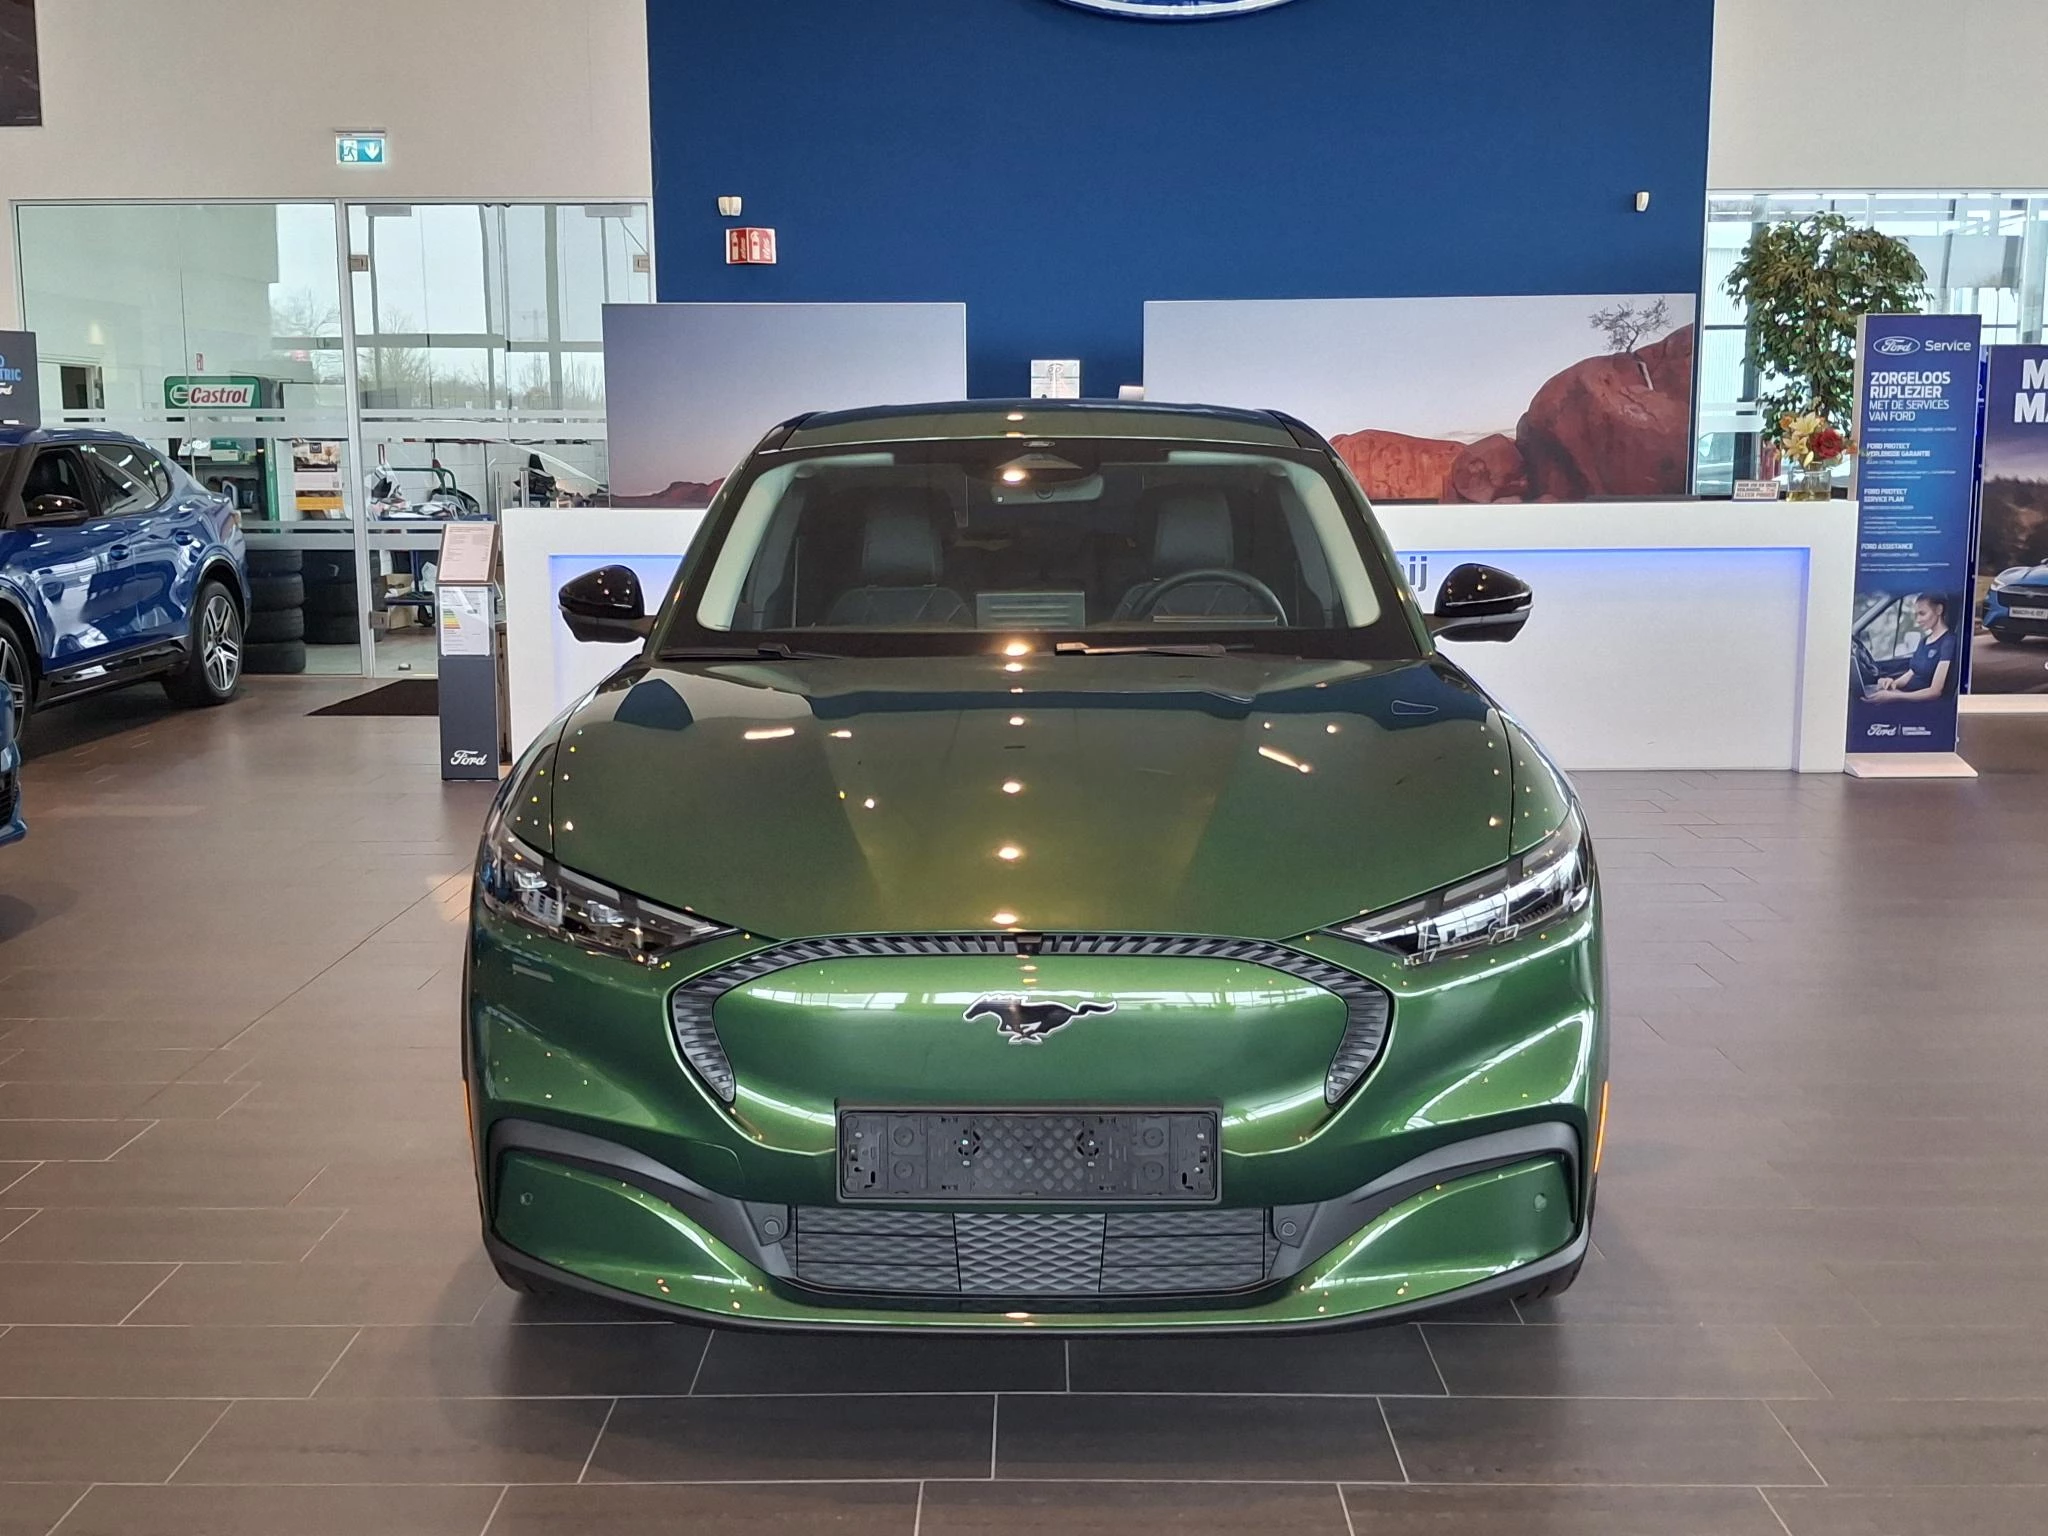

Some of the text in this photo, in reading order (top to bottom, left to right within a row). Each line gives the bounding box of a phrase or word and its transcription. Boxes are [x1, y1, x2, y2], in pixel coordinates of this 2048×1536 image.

[1881, 338, 1972, 352] Ford Service
[1870, 372, 1951, 385] ZORGELOOS
[191, 387, 248, 403] Castrol
[1870, 386, 1942, 399] RIJPLEZIER
[1869, 400, 1950, 410] MET DE SERVICES
[2014, 392, 2048, 423] M
[1869, 411, 1916, 422] VAN FORD
[1867, 723, 1897, 736] Ford
[450, 750, 488, 766] Ford
